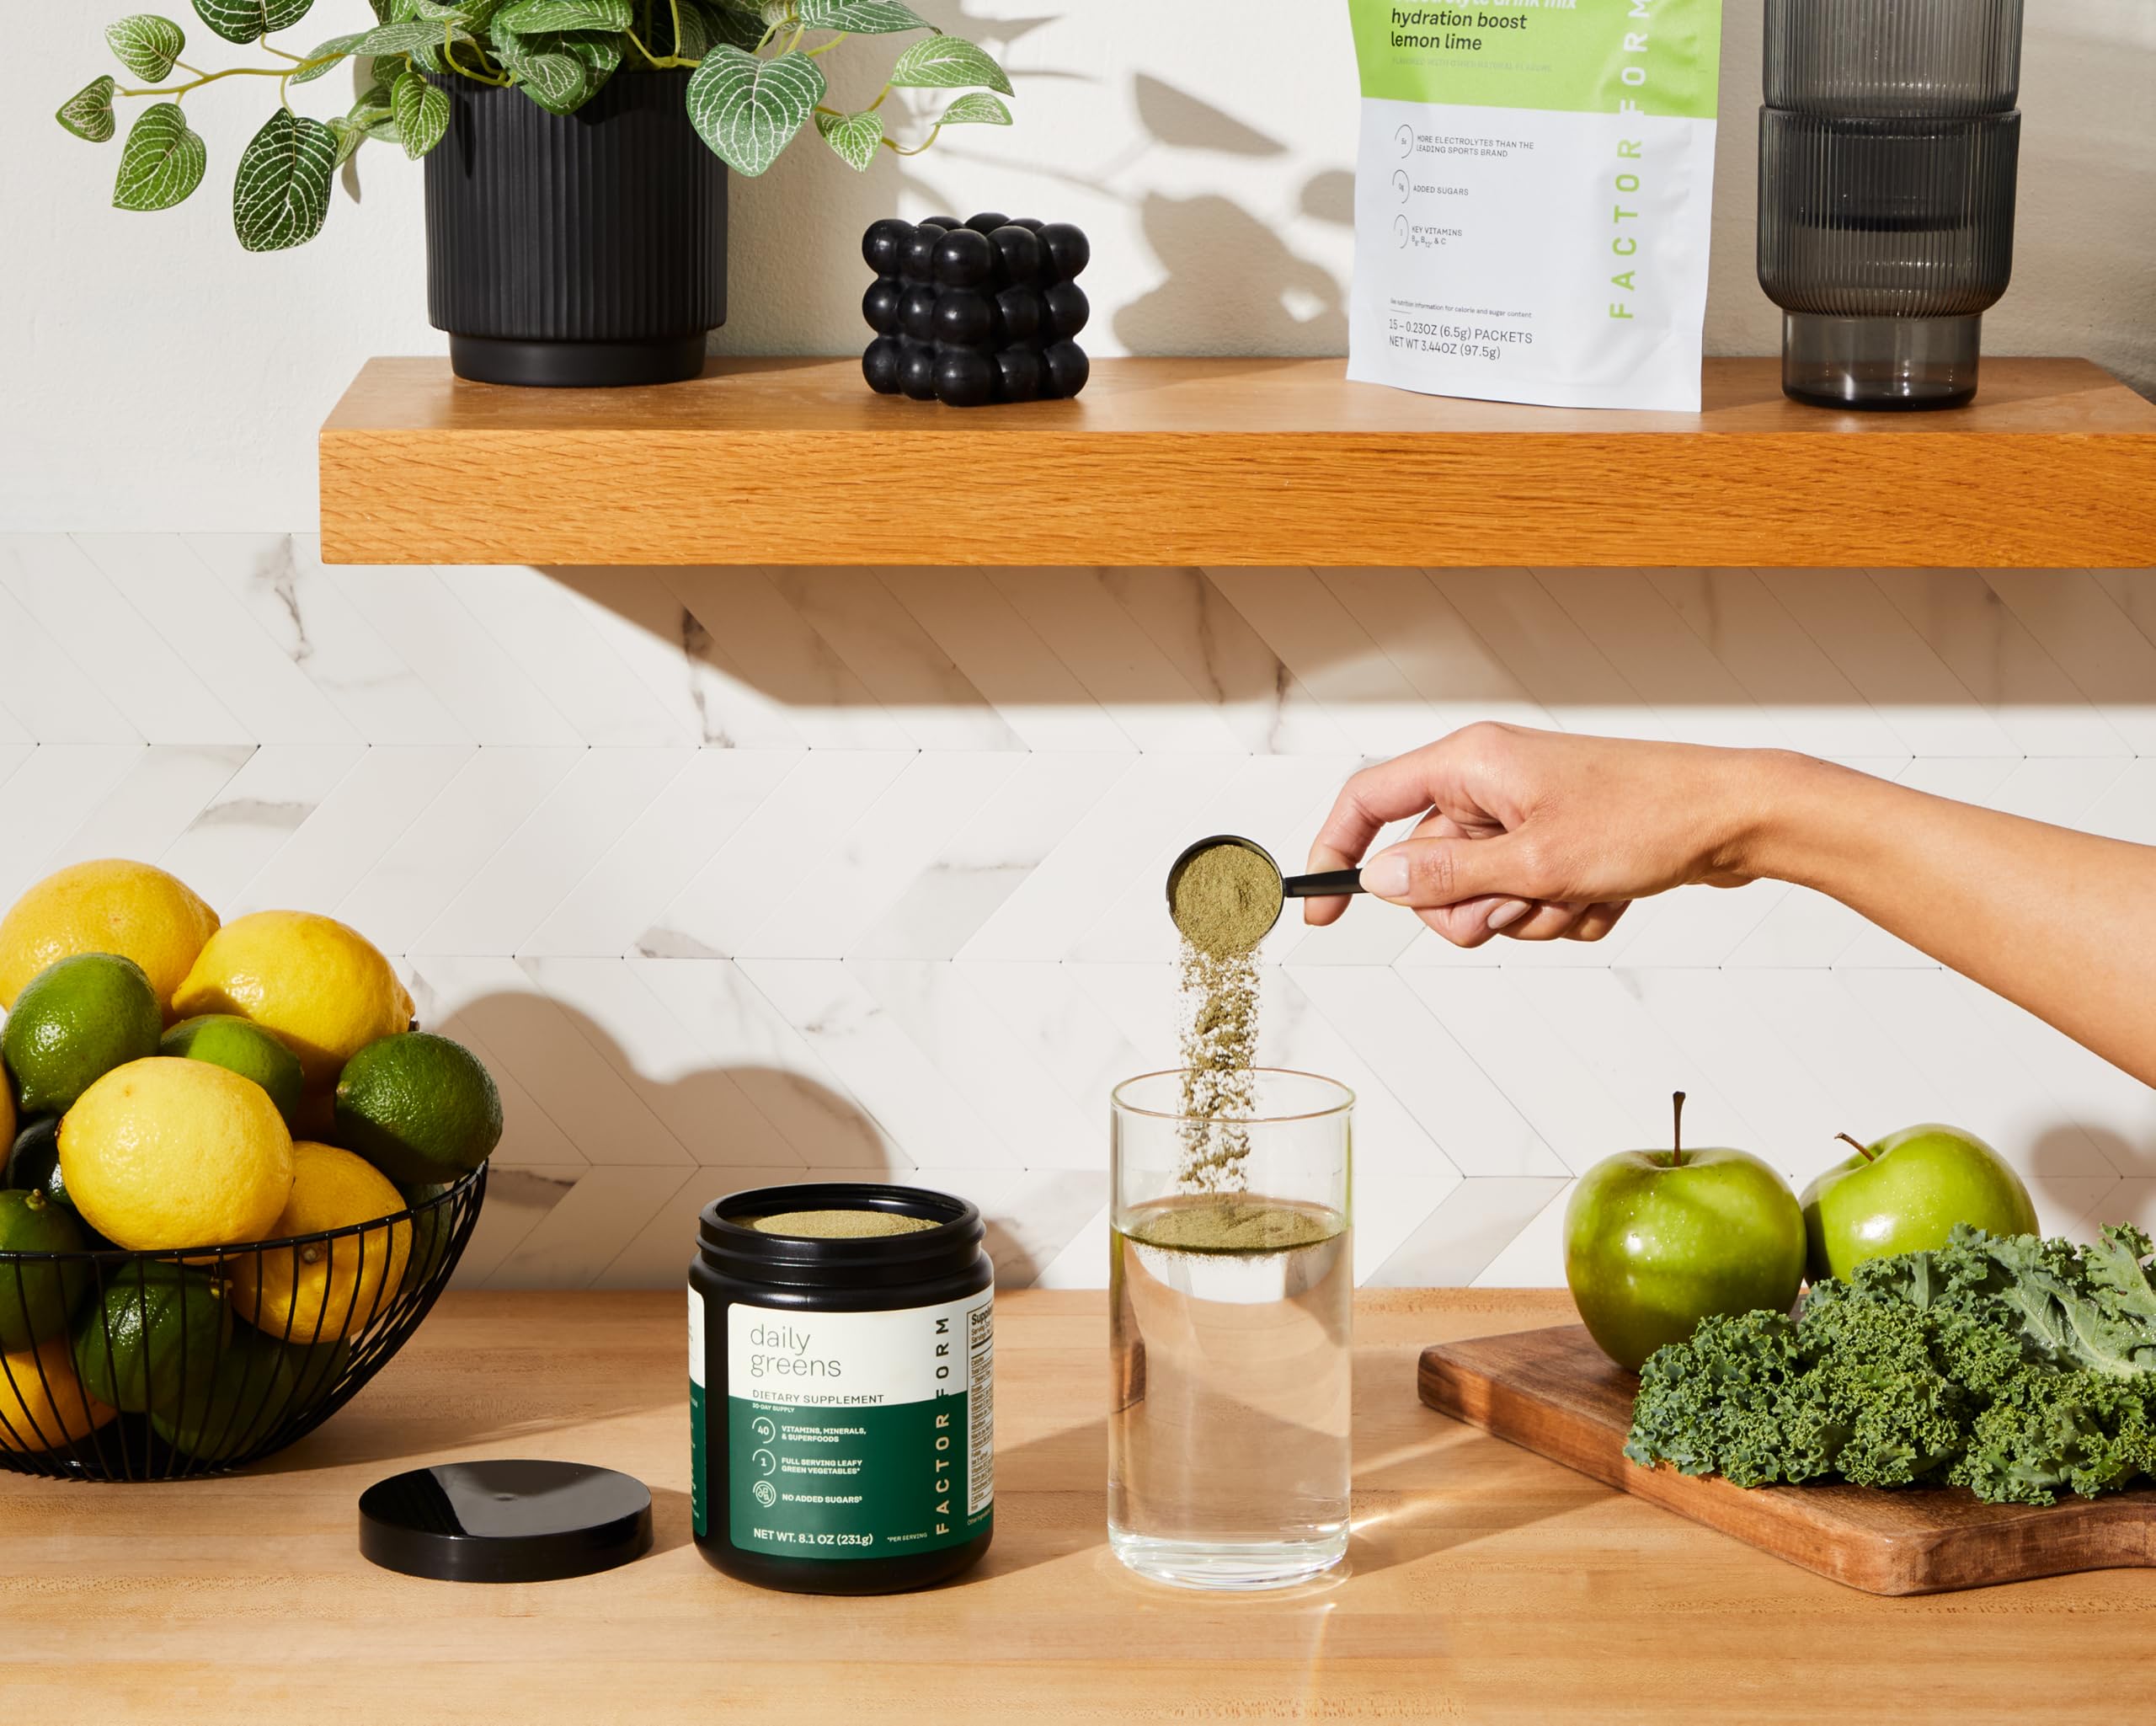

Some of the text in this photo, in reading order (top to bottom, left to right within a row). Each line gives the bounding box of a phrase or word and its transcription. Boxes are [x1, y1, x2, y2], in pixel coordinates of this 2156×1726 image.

[1391, 8, 1528, 29] hydration boost
[1391, 31, 1482, 51] lemon lime
[1417, 135, 1534, 150] MORE ELECTROLYTES THAN THE
[1417, 144, 1508, 158] LEADING SPORTS BRAND
[1413, 184, 1469, 195] ADDED SUGARS
[1425, 227, 1462, 237] VITAMINS
[1609, 139, 1641, 319] FACTOR
[1390, 318, 1398, 330] 15
[1440, 323, 1471, 341] (6.5g)
[1475, 329, 1533, 345] PACKETS
[1390, 335, 1502, 361] NET WT 3.44OZ (97.5g)
[750, 1323, 811, 1355] daily
[750, 1354, 841, 1377] greens
[752, 1389, 884, 1404] DIETARY SUPPLEMENT
[772, 1404, 795, 1413] SUPPLY
[758, 1425, 770, 1435] 40
[782, 1425, 867, 1435] VITAMINS, MINERALS,
[788, 1435, 840, 1443] SUPERFOODS
[760, 1457, 767, 1467] 1
[782, 1456, 800, 1466] FULL
[801, 1458, 836, 1467] SERVING
[782, 1465, 807, 1473] GREEN
[936, 1413, 950, 1536] FACTOR
[782, 1494, 794, 1502] NO
[795, 1494, 824, 1503] ADDED
[753, 1528, 873, 1547] NET WT. 8.1 OZ (231g)
